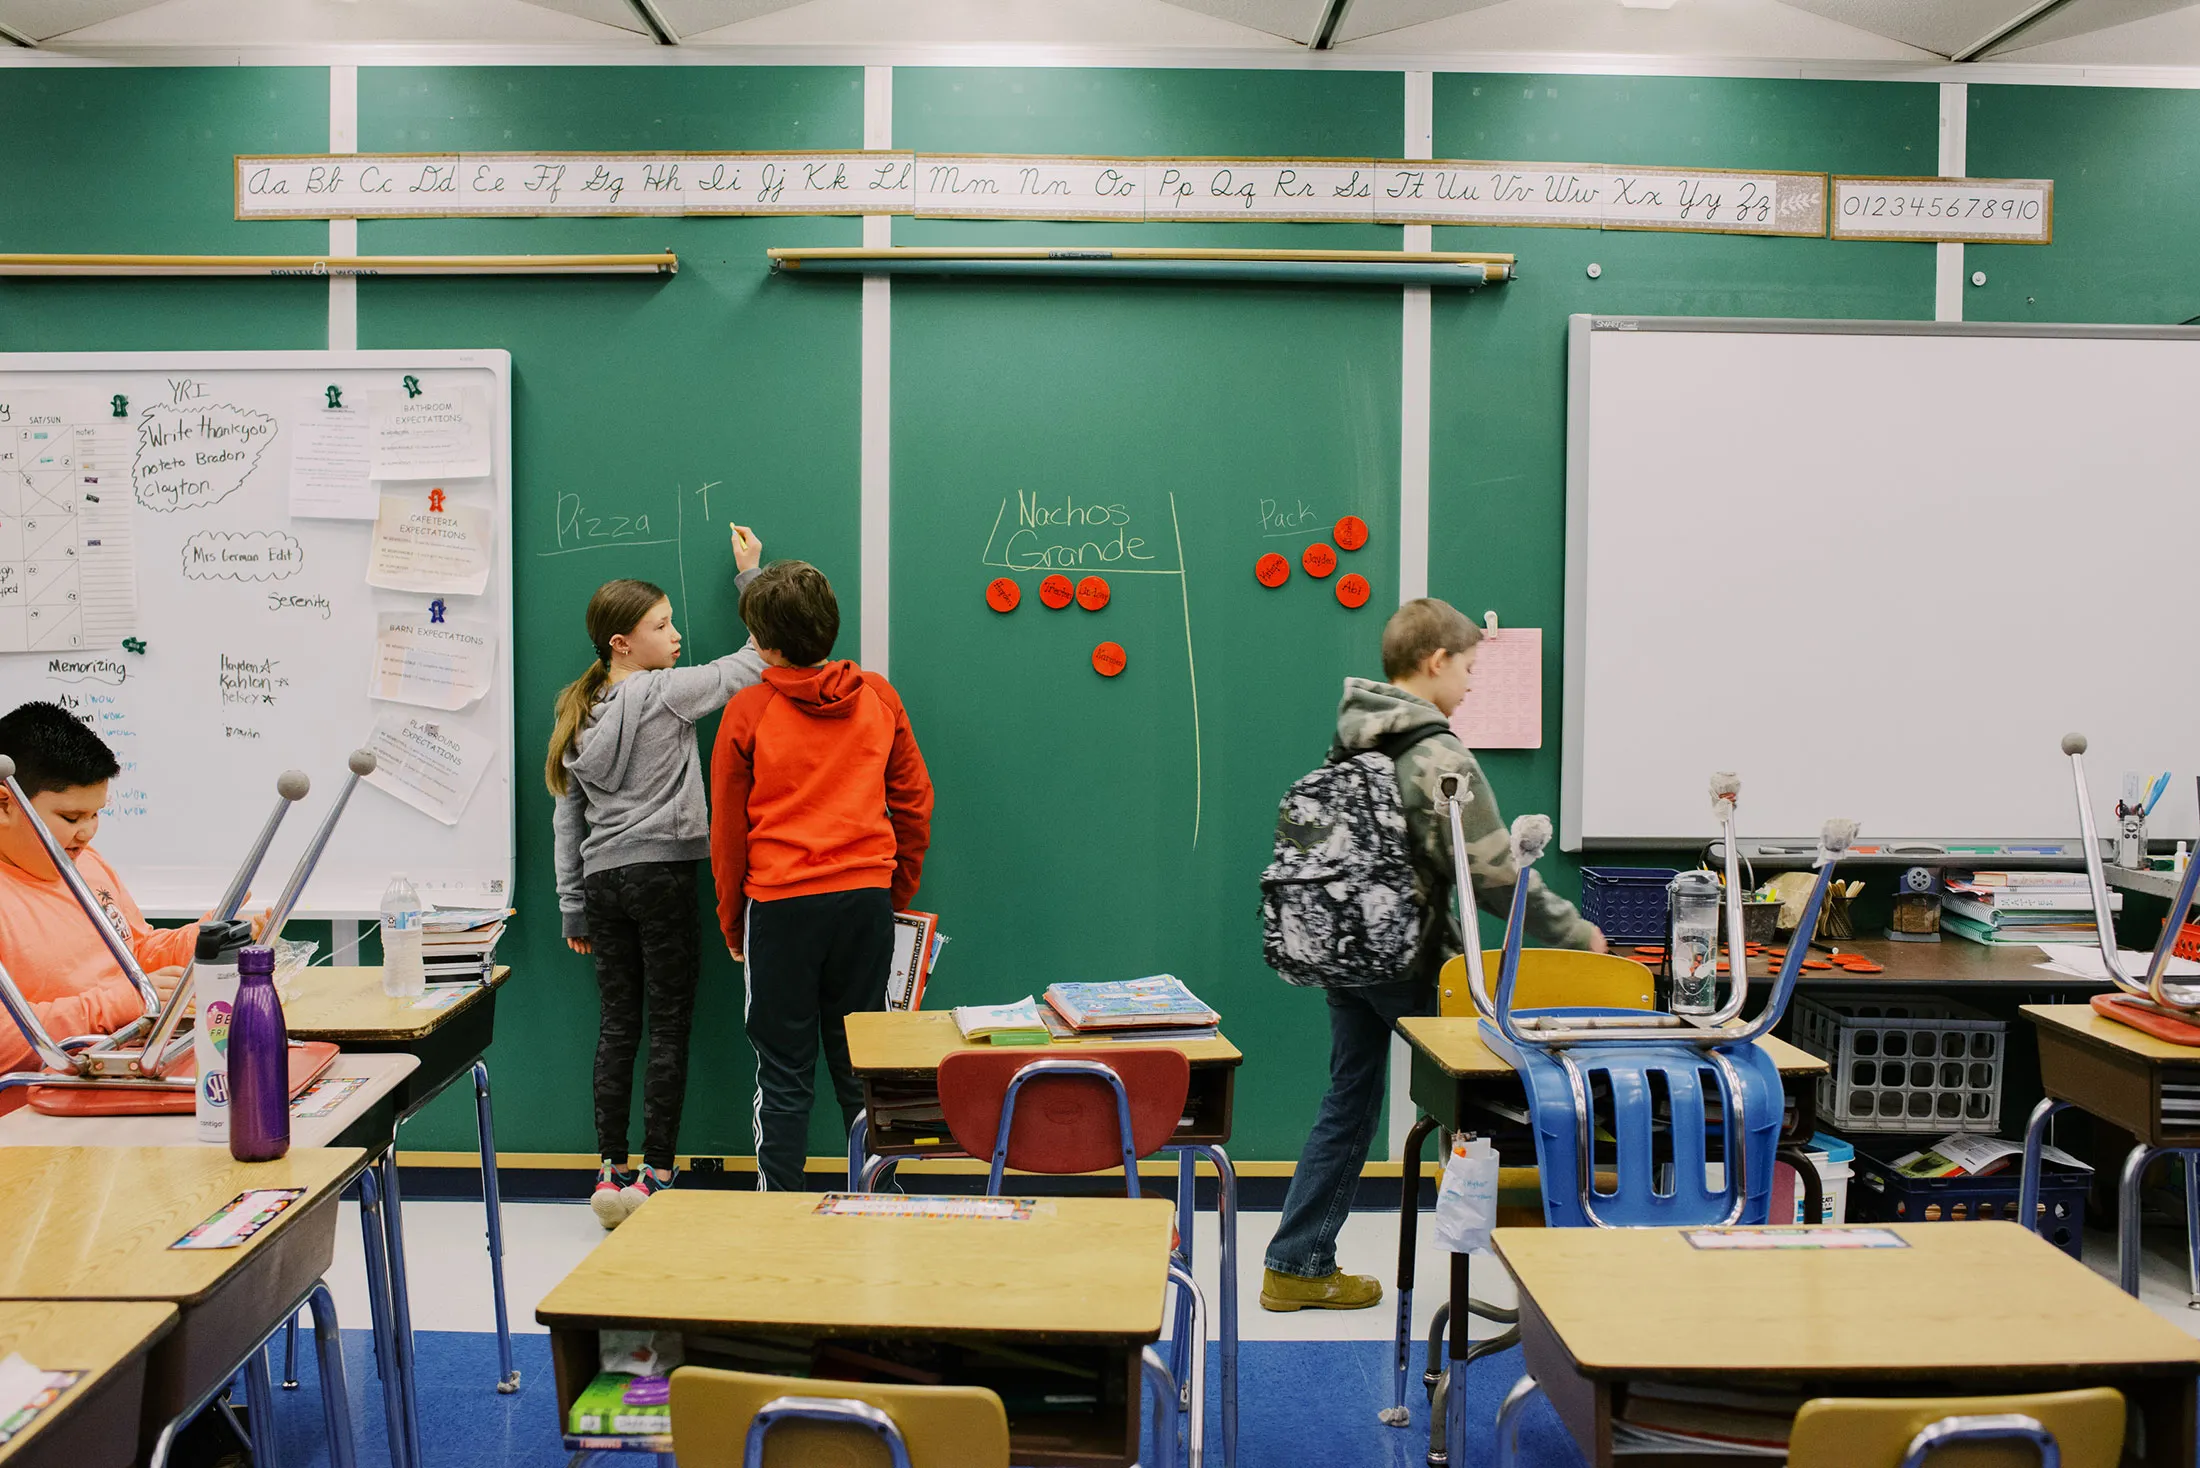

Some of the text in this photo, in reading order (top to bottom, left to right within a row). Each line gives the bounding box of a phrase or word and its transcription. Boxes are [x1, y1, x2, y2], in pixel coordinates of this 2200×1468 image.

[249, 162, 1772, 223] Aa Bb Cc Dd Ee Ff Gg Hh Ii Jj Kk Ll Mm Nn Oo Pp Qq Rr Ss Tt Uu Vv Ww Xx Yy Zz
[167, 378, 211, 405] YRI
[395, 414, 463, 425] EXPECTATIONS
[403, 402, 454, 413] BATHROOM
[147, 417, 193, 448] Write
[695, 480, 723, 521] T
[1017, 488, 1131, 529] Nachos
[1256, 498, 1319, 531] Pack
[399, 524, 467, 541] EXPECTATIONS
[410, 514, 459, 528] CAFETERIA
[556, 490, 651, 549] Pizza
[268, 546, 293, 562] Edit
[1004, 527, 1156, 572] Grande
[267, 591, 332, 621] Serenity
[389, 624, 484, 646] BARN EXPECTATIONS
[48, 658, 127, 684] Memorizing
[401, 727, 463, 767] EXPECTATIONS
